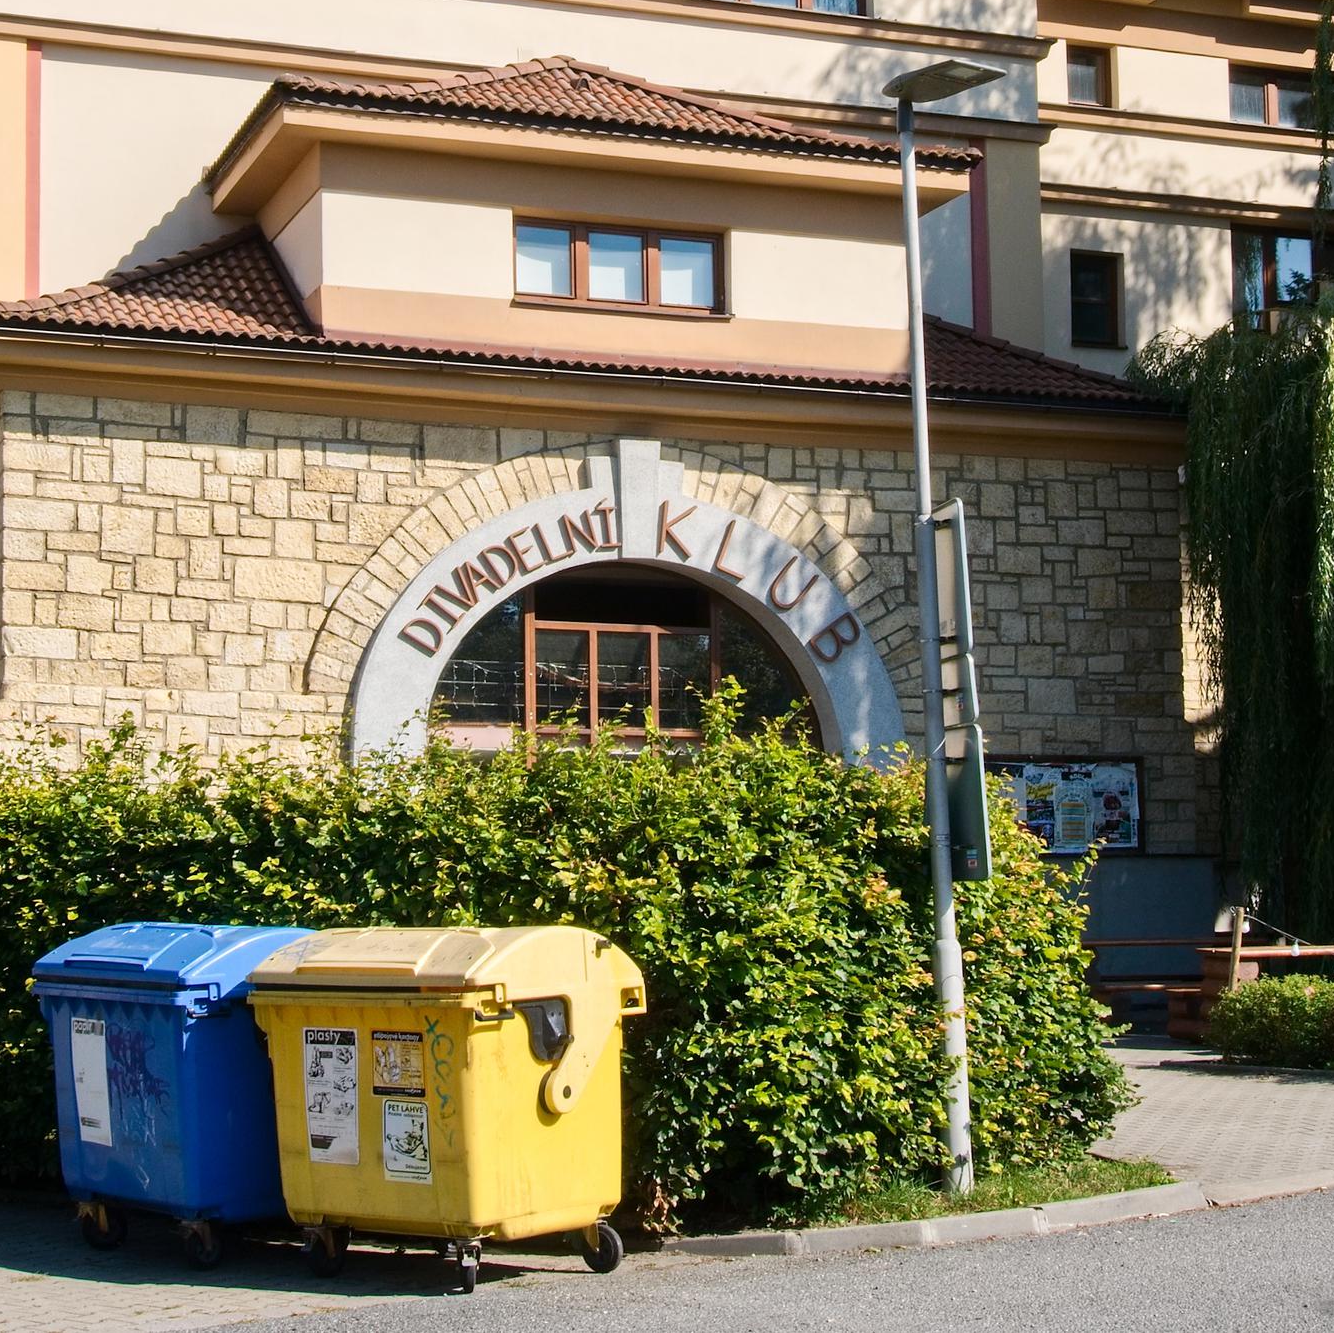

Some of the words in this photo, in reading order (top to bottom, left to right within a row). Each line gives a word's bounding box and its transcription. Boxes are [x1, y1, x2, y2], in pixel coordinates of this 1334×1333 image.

[401, 498, 622, 655] DIVADELNÍ
[658, 499, 861, 663] KLUB
[307, 1029, 341, 1045] plasty
[388, 1104, 399, 1112] PET
